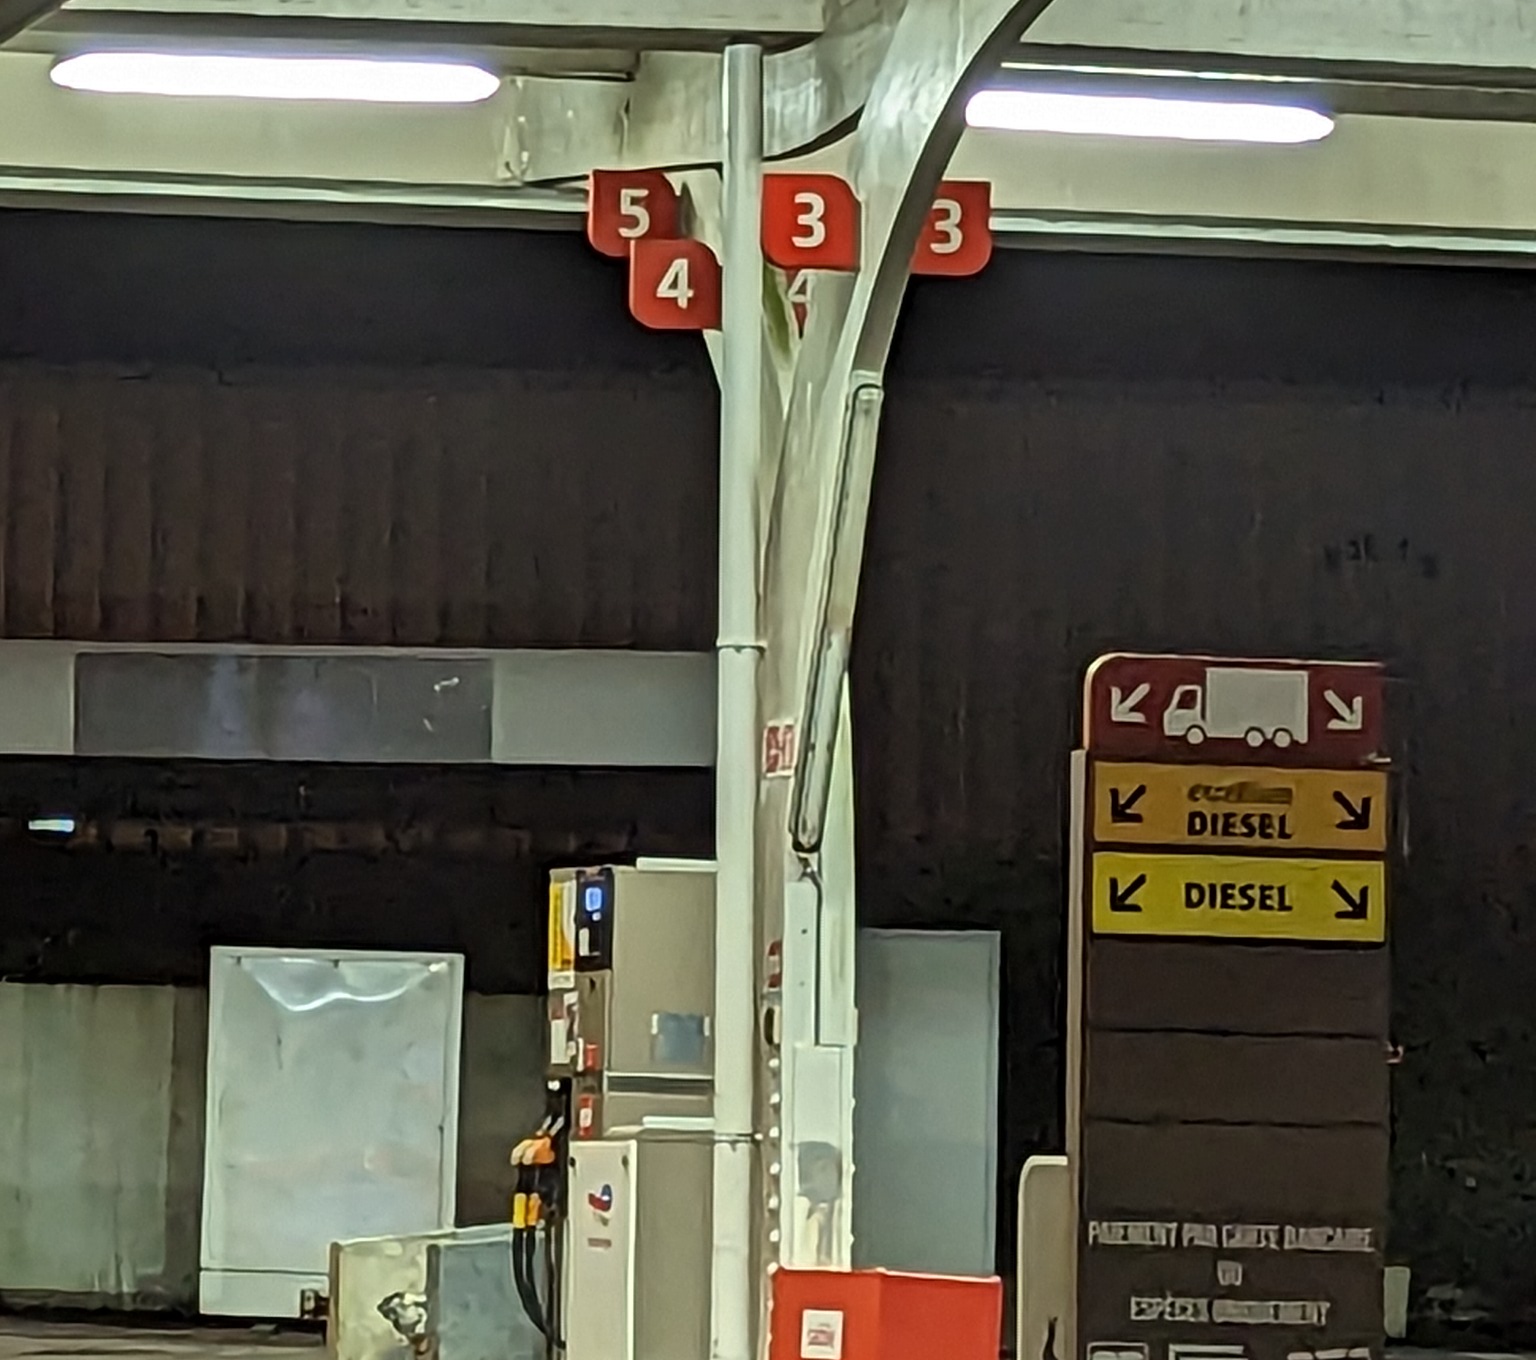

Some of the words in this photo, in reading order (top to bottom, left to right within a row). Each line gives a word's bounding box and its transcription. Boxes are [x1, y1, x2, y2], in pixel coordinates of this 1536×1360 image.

[617, 187, 651, 239] 5
[791, 191, 827, 248] 3
[929, 198, 963, 254] 3
[655, 257, 694, 311] 4
[1187, 810, 1293, 840] DIESEL
[1183, 881, 1293, 912] DIESEL
